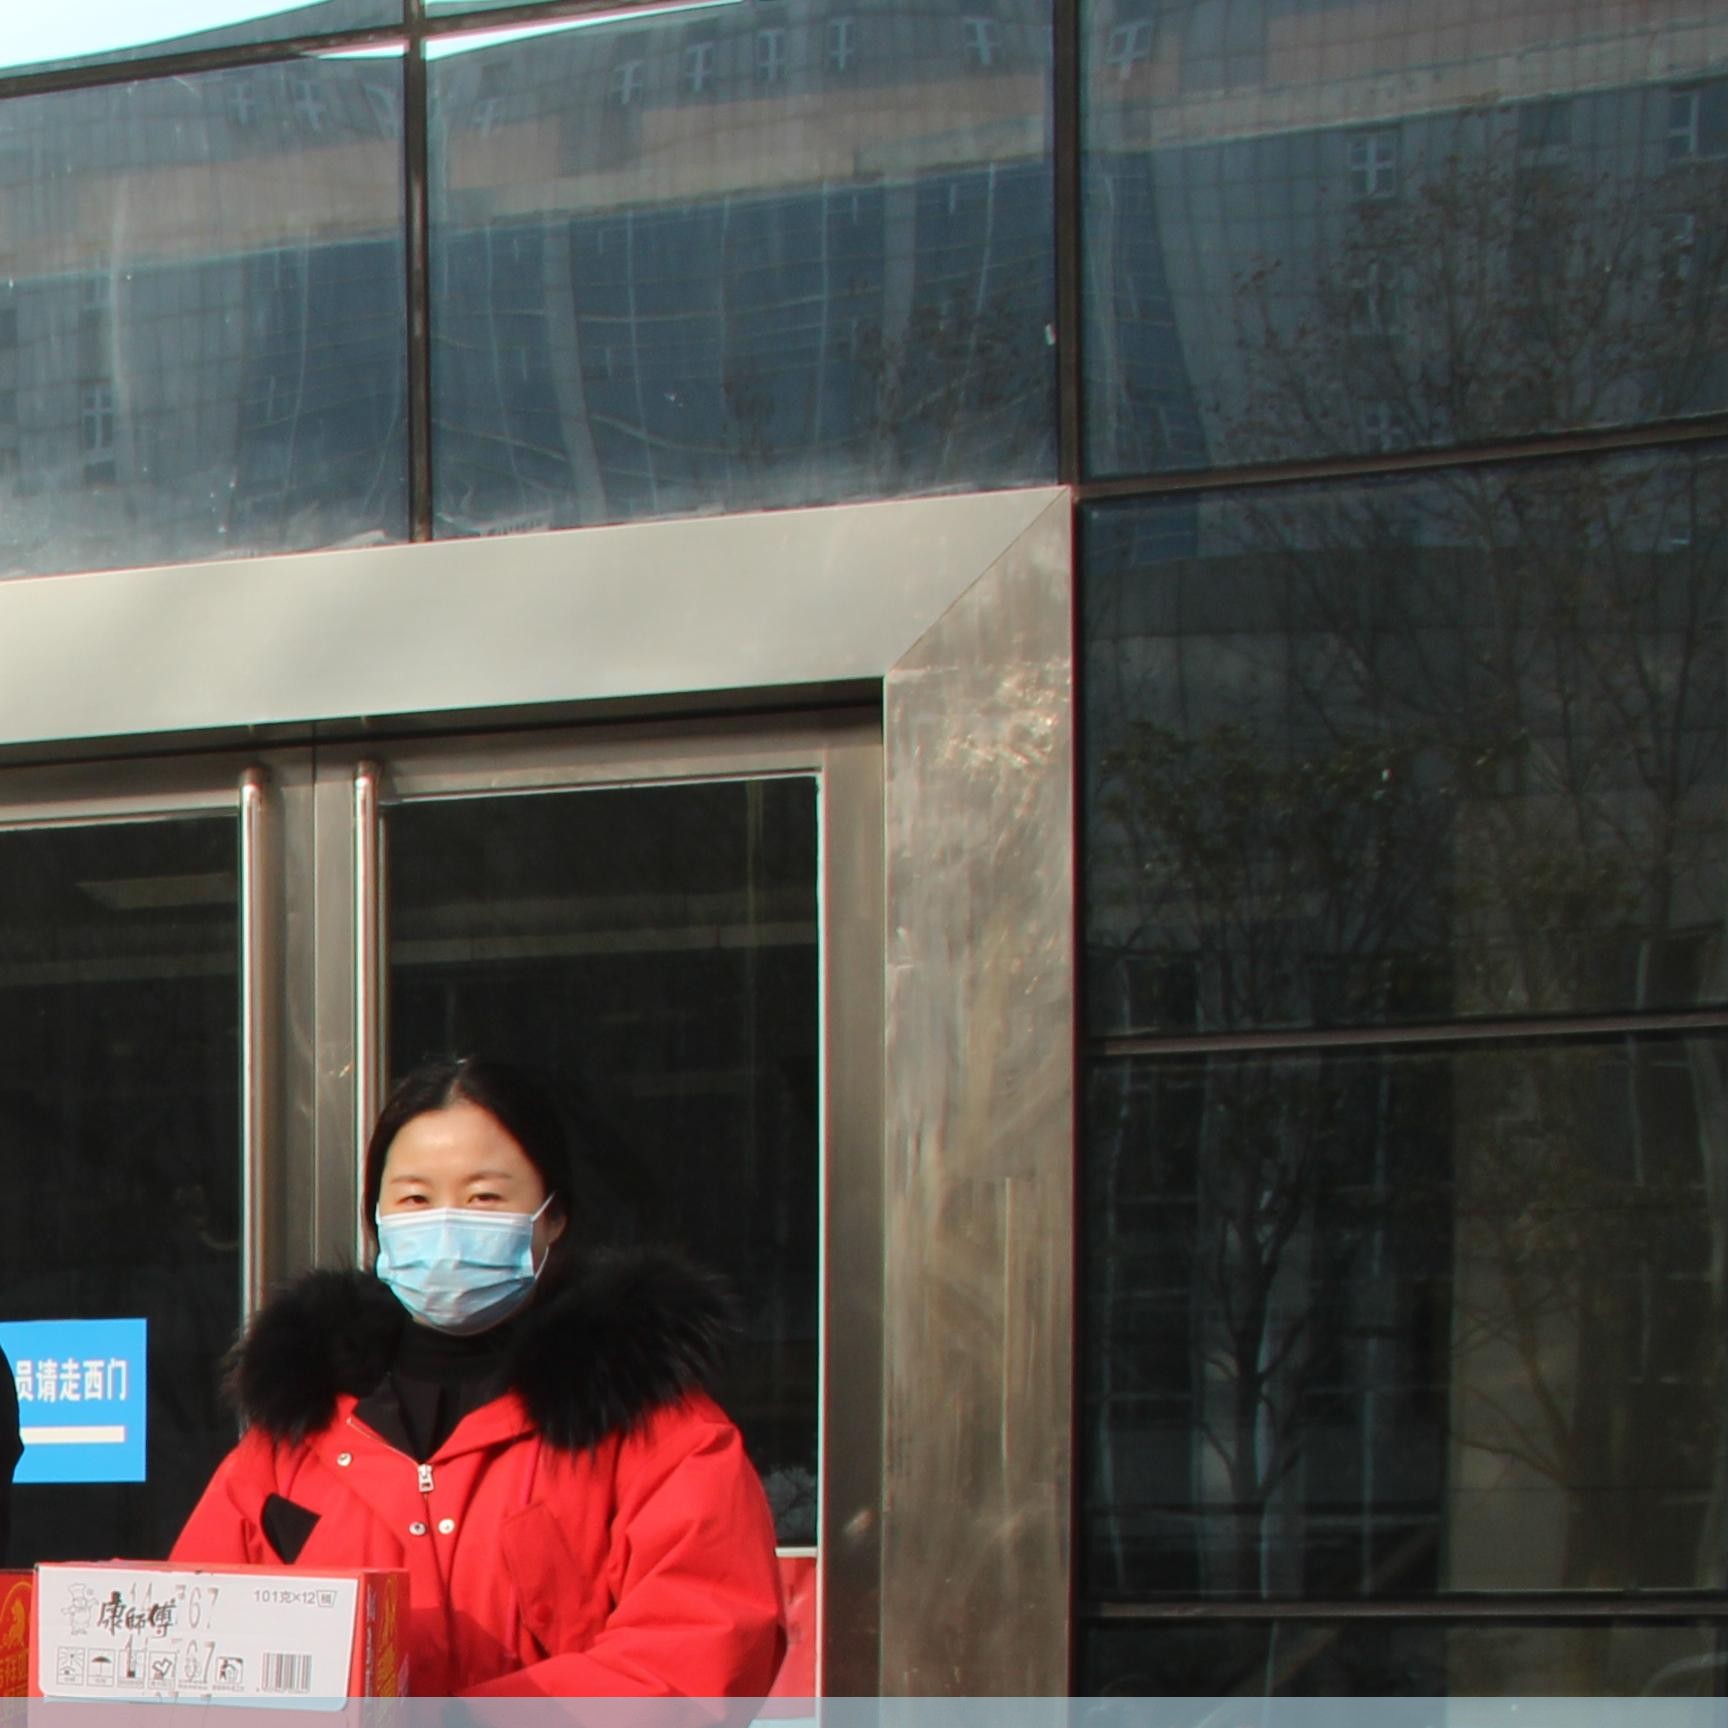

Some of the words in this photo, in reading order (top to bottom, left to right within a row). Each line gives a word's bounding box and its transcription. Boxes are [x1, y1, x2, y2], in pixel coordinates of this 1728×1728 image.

[15, 1358, 127, 1403] 员请走西门
